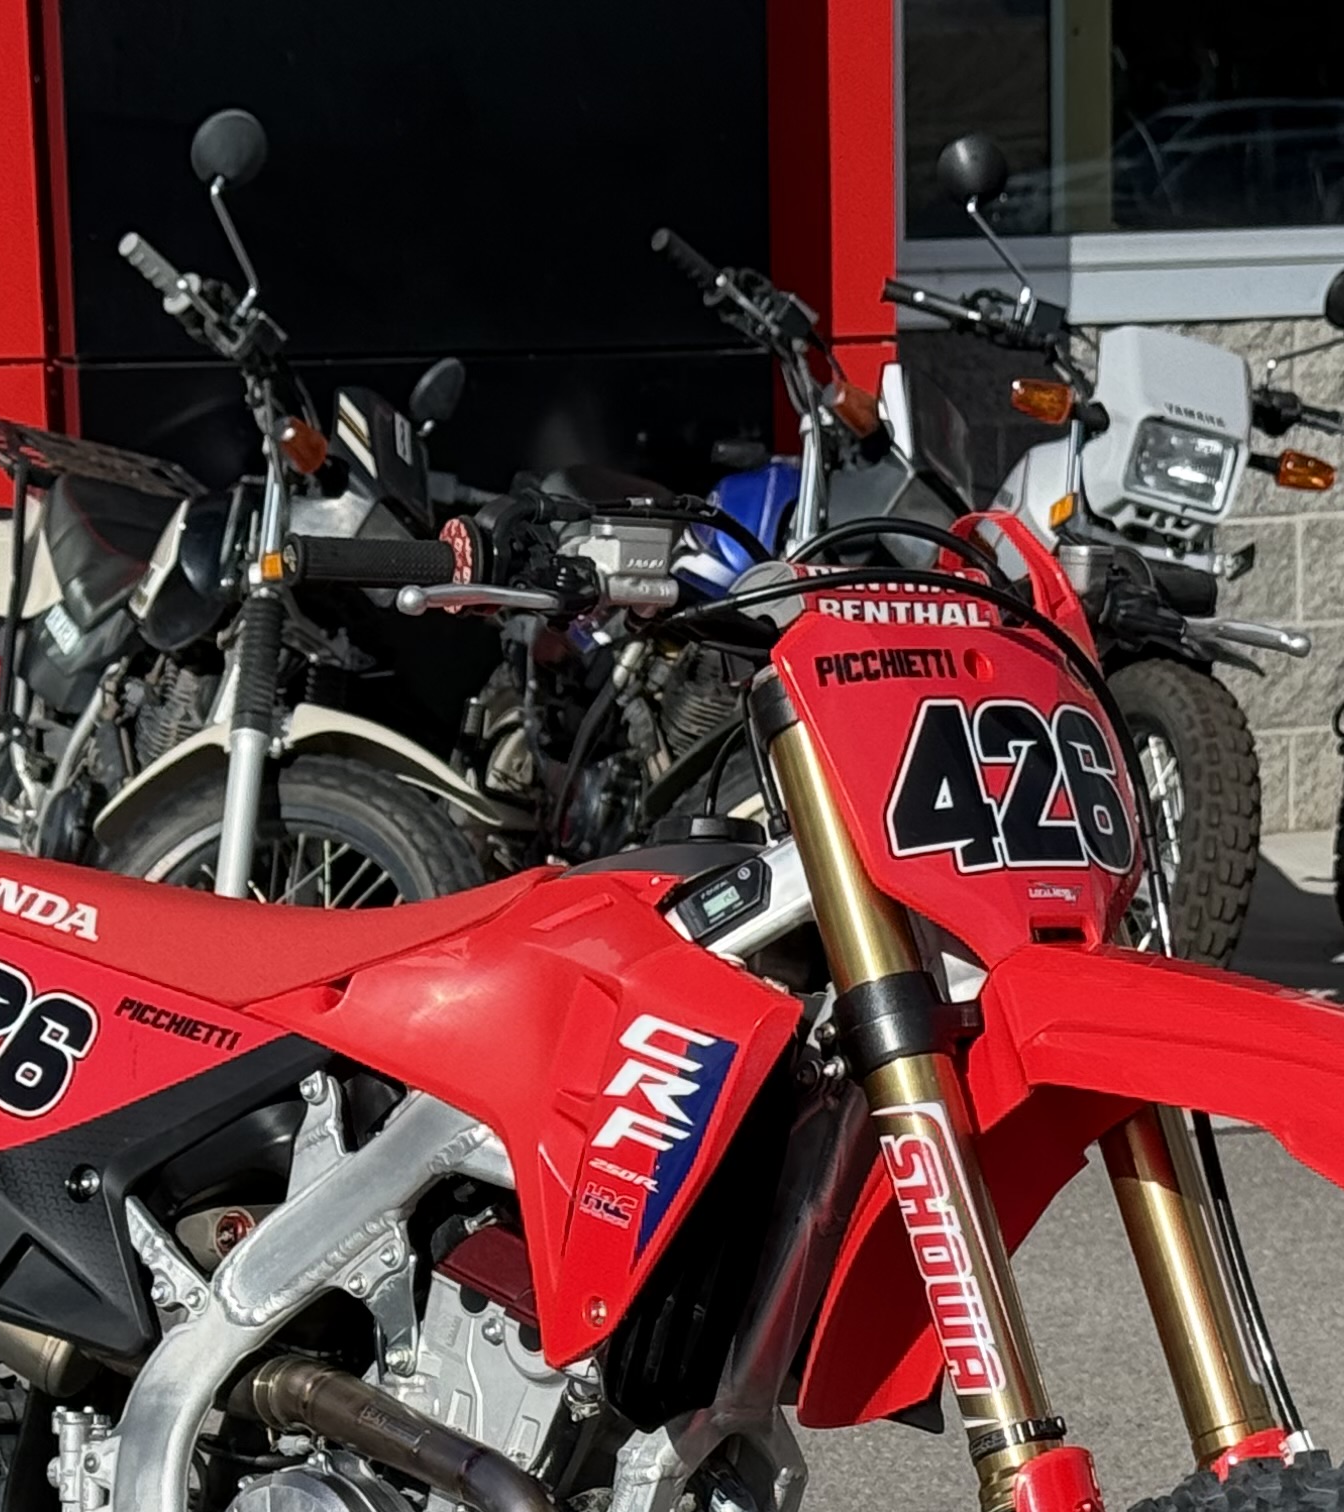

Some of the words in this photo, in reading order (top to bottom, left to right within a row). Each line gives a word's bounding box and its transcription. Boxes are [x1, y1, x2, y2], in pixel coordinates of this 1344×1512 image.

[818, 598, 991, 628] RENTHAL
[814, 648, 958, 687] PICCHIETTI
[885, 698, 1136, 875] 426
[114, 995, 243, 1051] PICCHIETTI
[591, 1013, 718, 1151] CRF
[588, 1157, 660, 1193] 250R
[880, 1135, 1006, 1394] SHOWA
